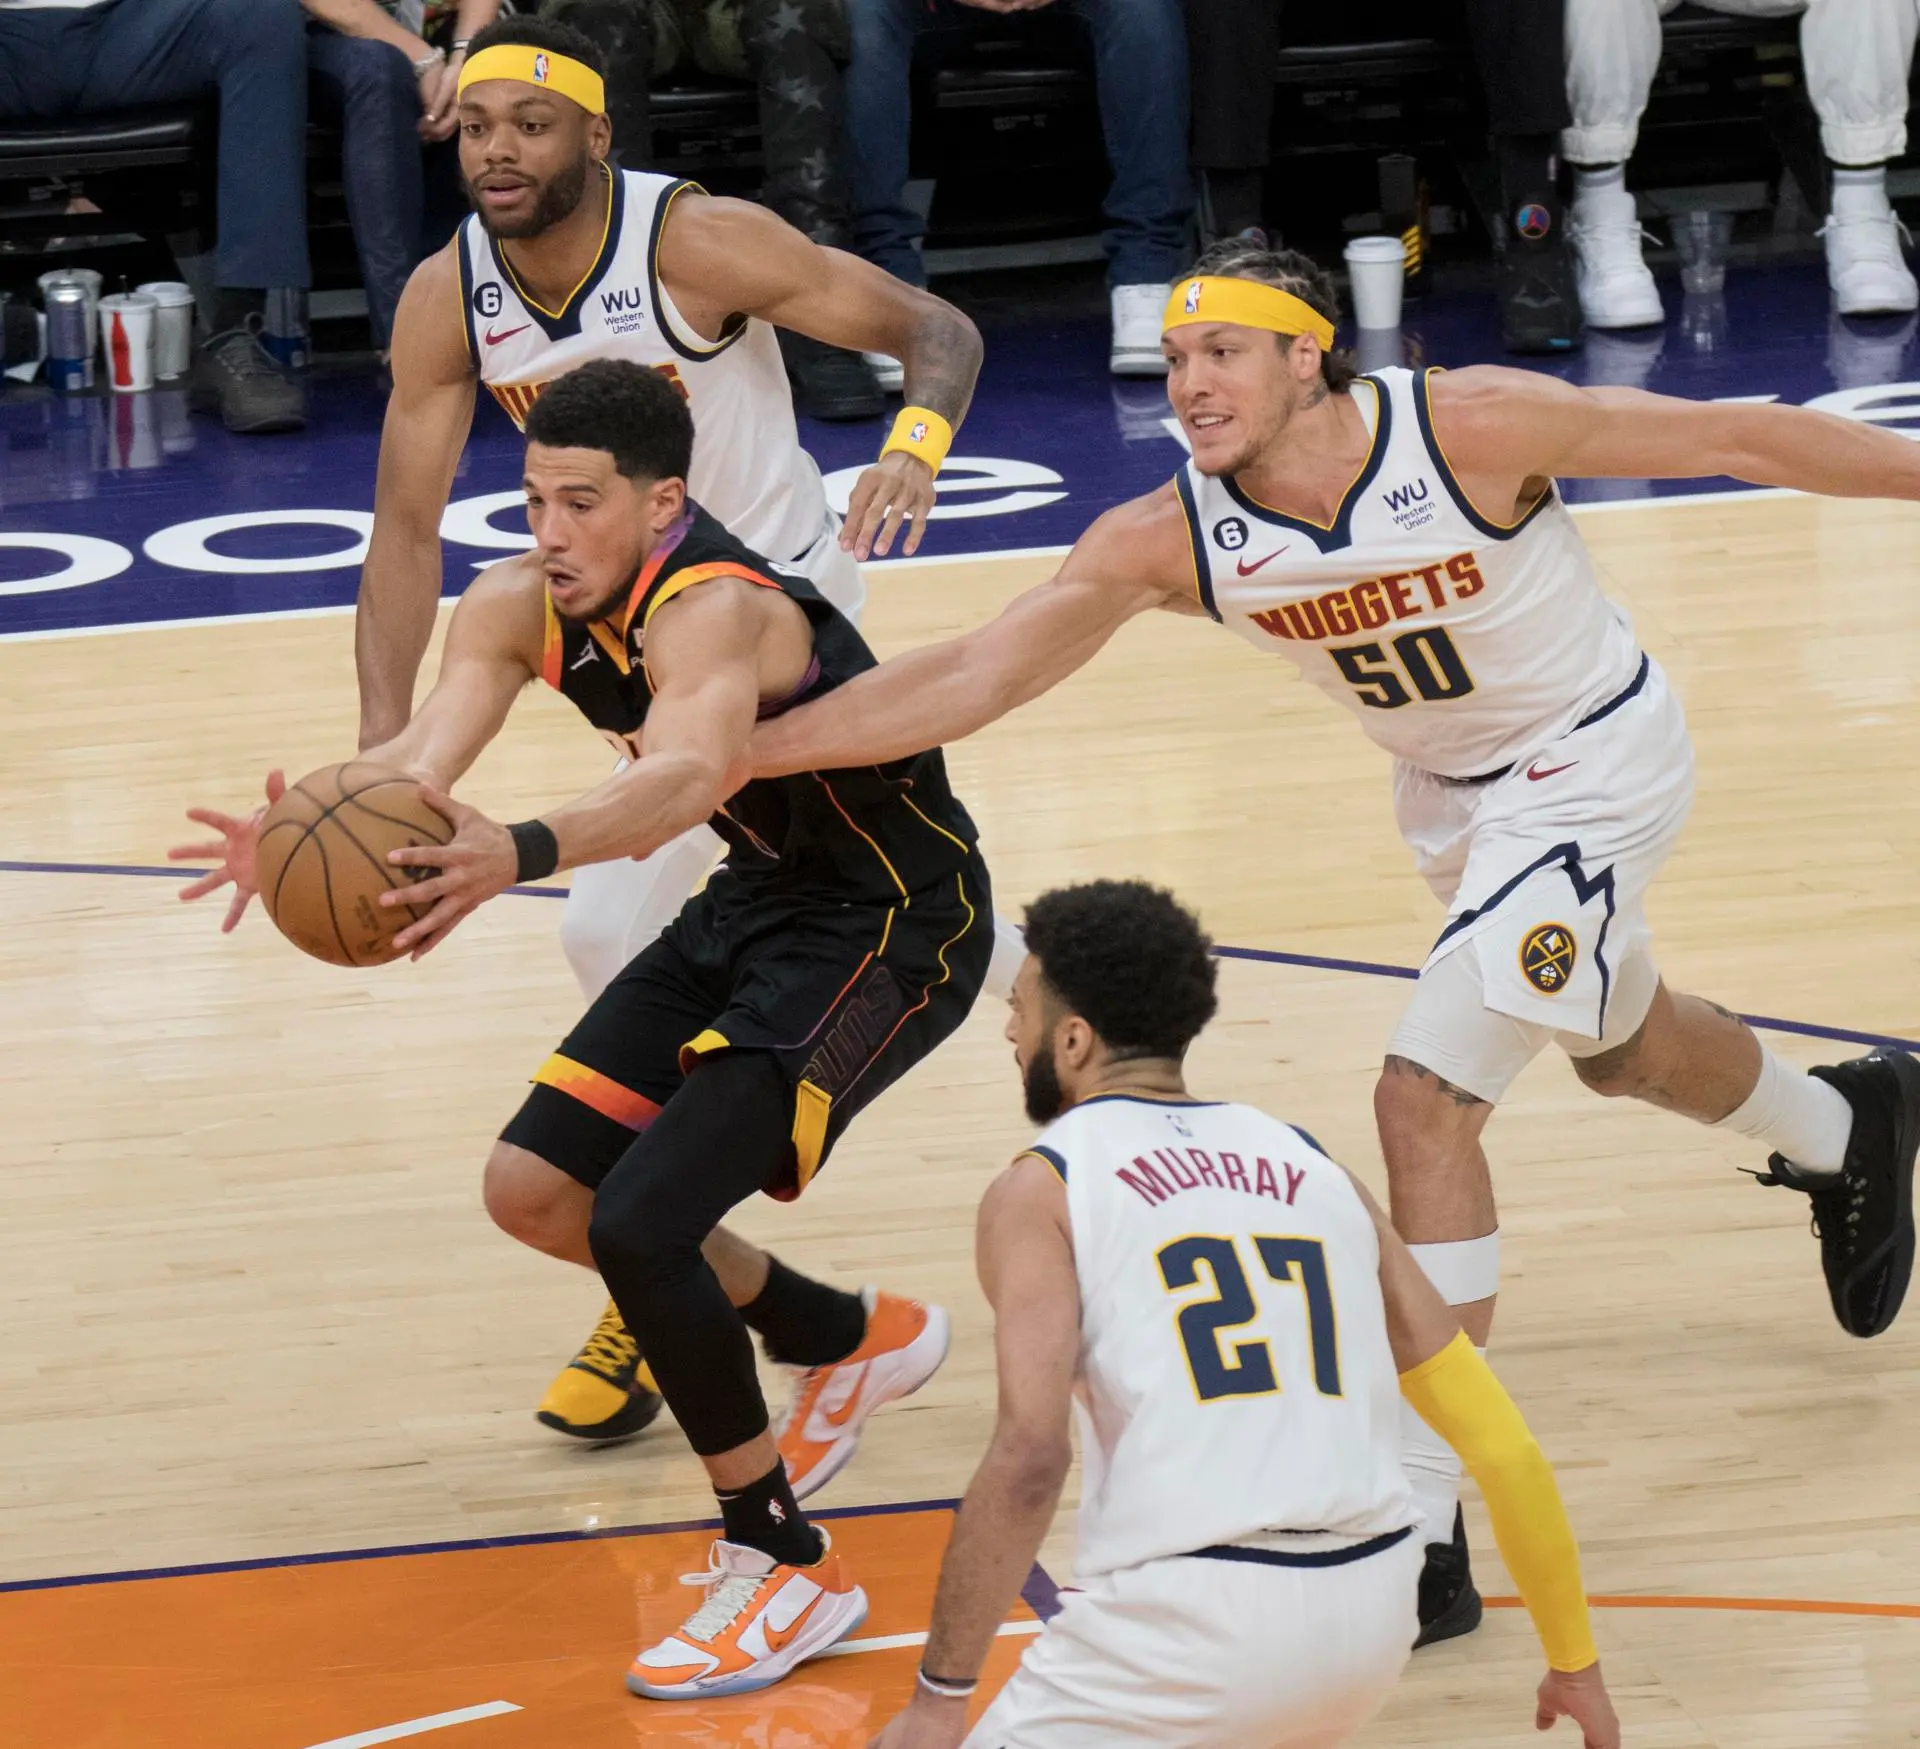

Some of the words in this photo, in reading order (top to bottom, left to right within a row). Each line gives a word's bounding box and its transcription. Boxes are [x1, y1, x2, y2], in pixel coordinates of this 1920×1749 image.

[481, 287, 501, 313] 6
[601, 286, 641, 314] WU
[604, 311, 645, 326] Western
[612, 322, 641, 334] Union
[1383, 477, 1429, 512] WU
[1392, 500, 1436, 525] Western
[1404, 512, 1434, 531] Union
[1220, 521, 1243, 548] 6
[1246, 551, 1485, 641] NUGGETS
[1323, 625, 1476, 709] 50
[1115, 1147, 1307, 1207] MURRAY
[1153, 1233, 1346, 1406] 27
